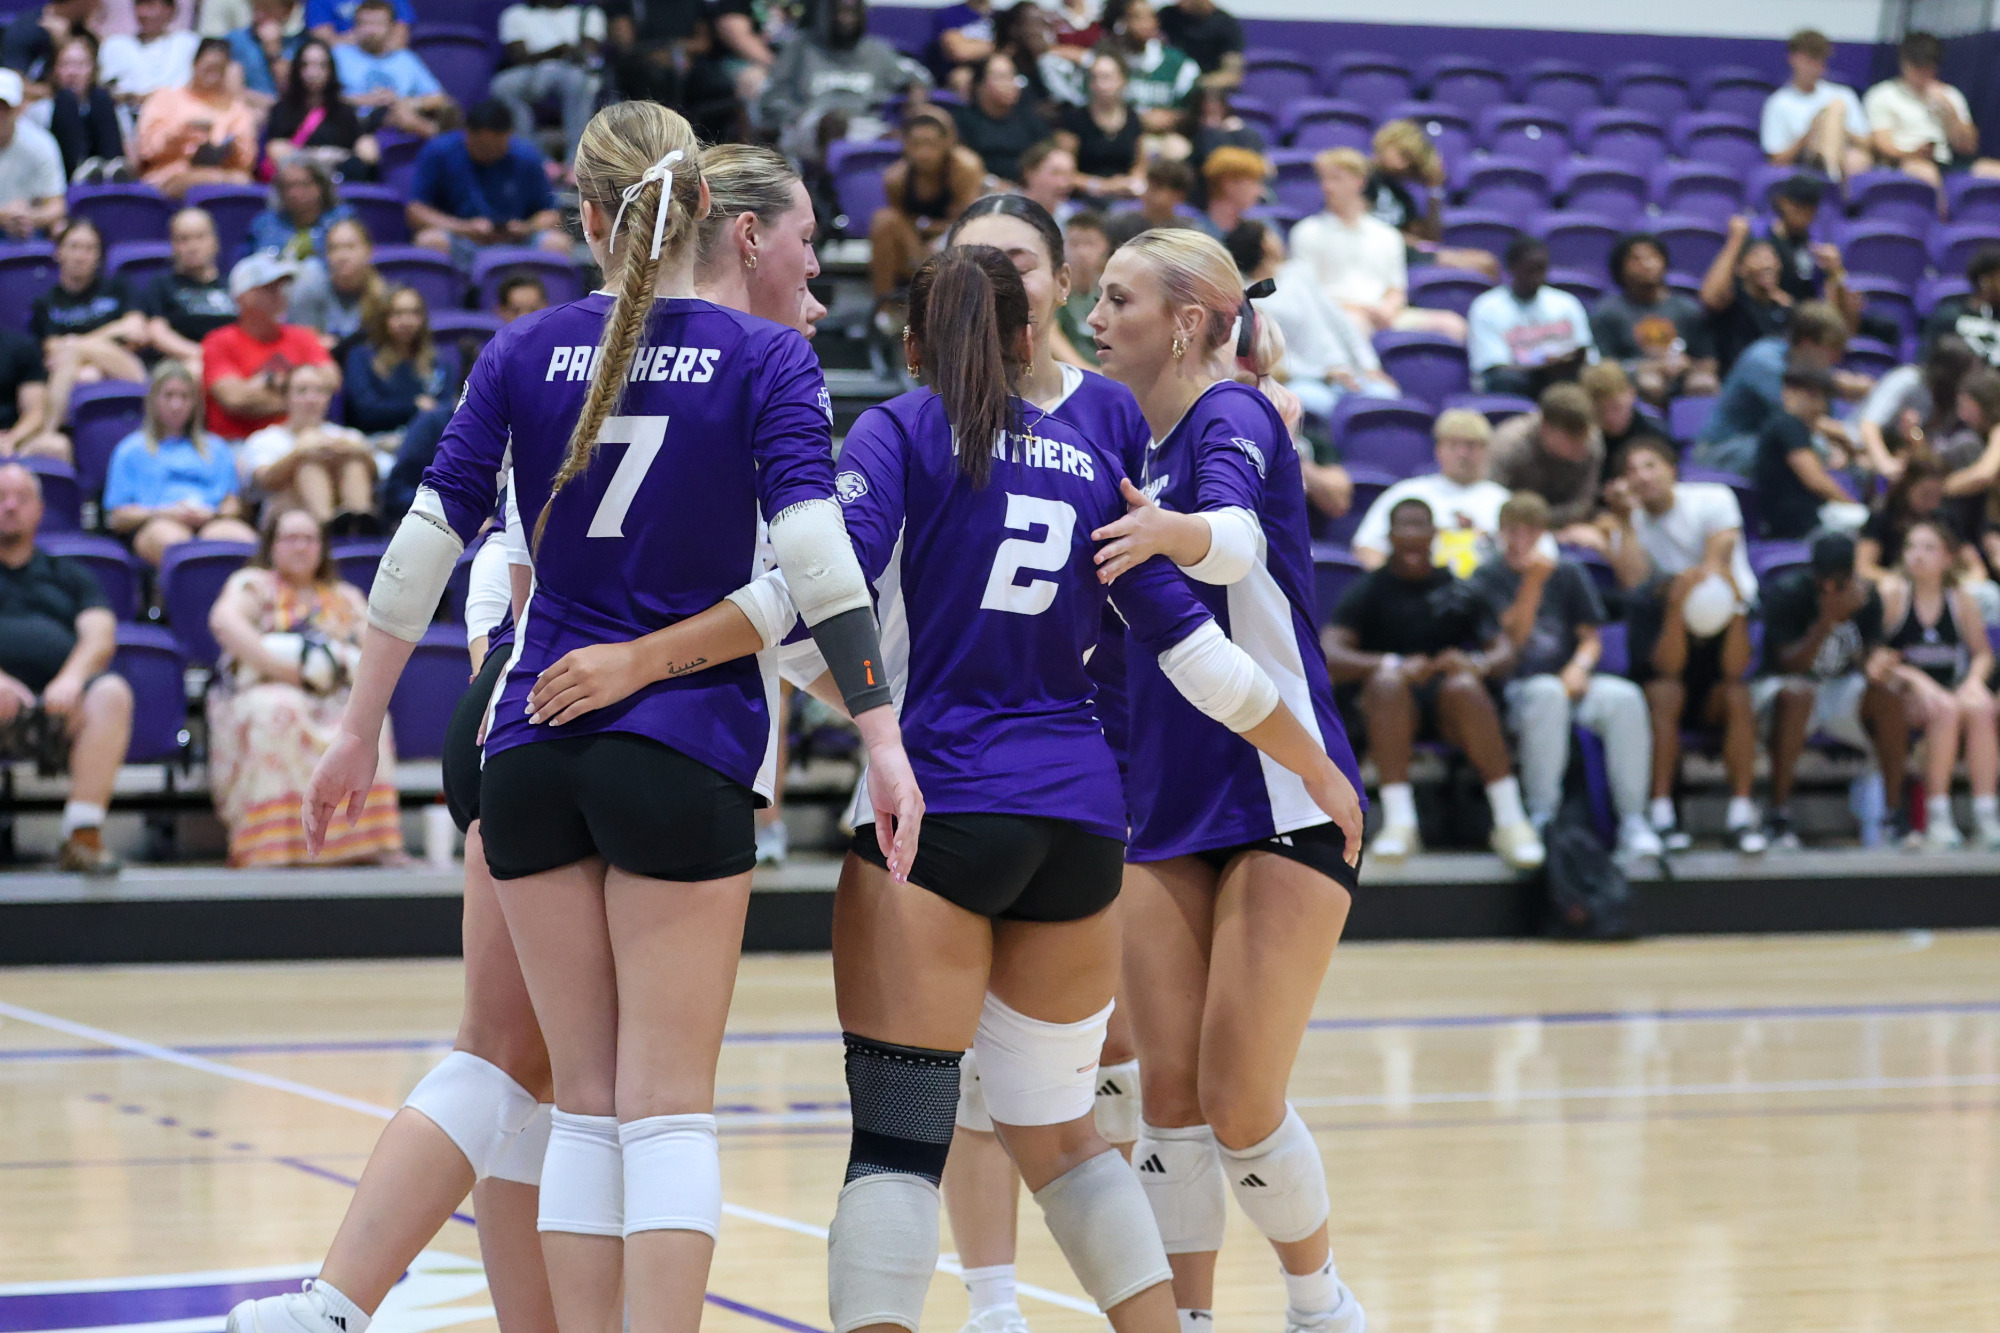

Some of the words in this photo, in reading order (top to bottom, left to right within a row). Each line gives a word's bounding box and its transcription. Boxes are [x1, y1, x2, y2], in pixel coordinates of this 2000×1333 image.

[545, 345, 721, 383] PAHERS
[586, 416, 669, 537] 7
[980, 491, 1077, 615] 2
